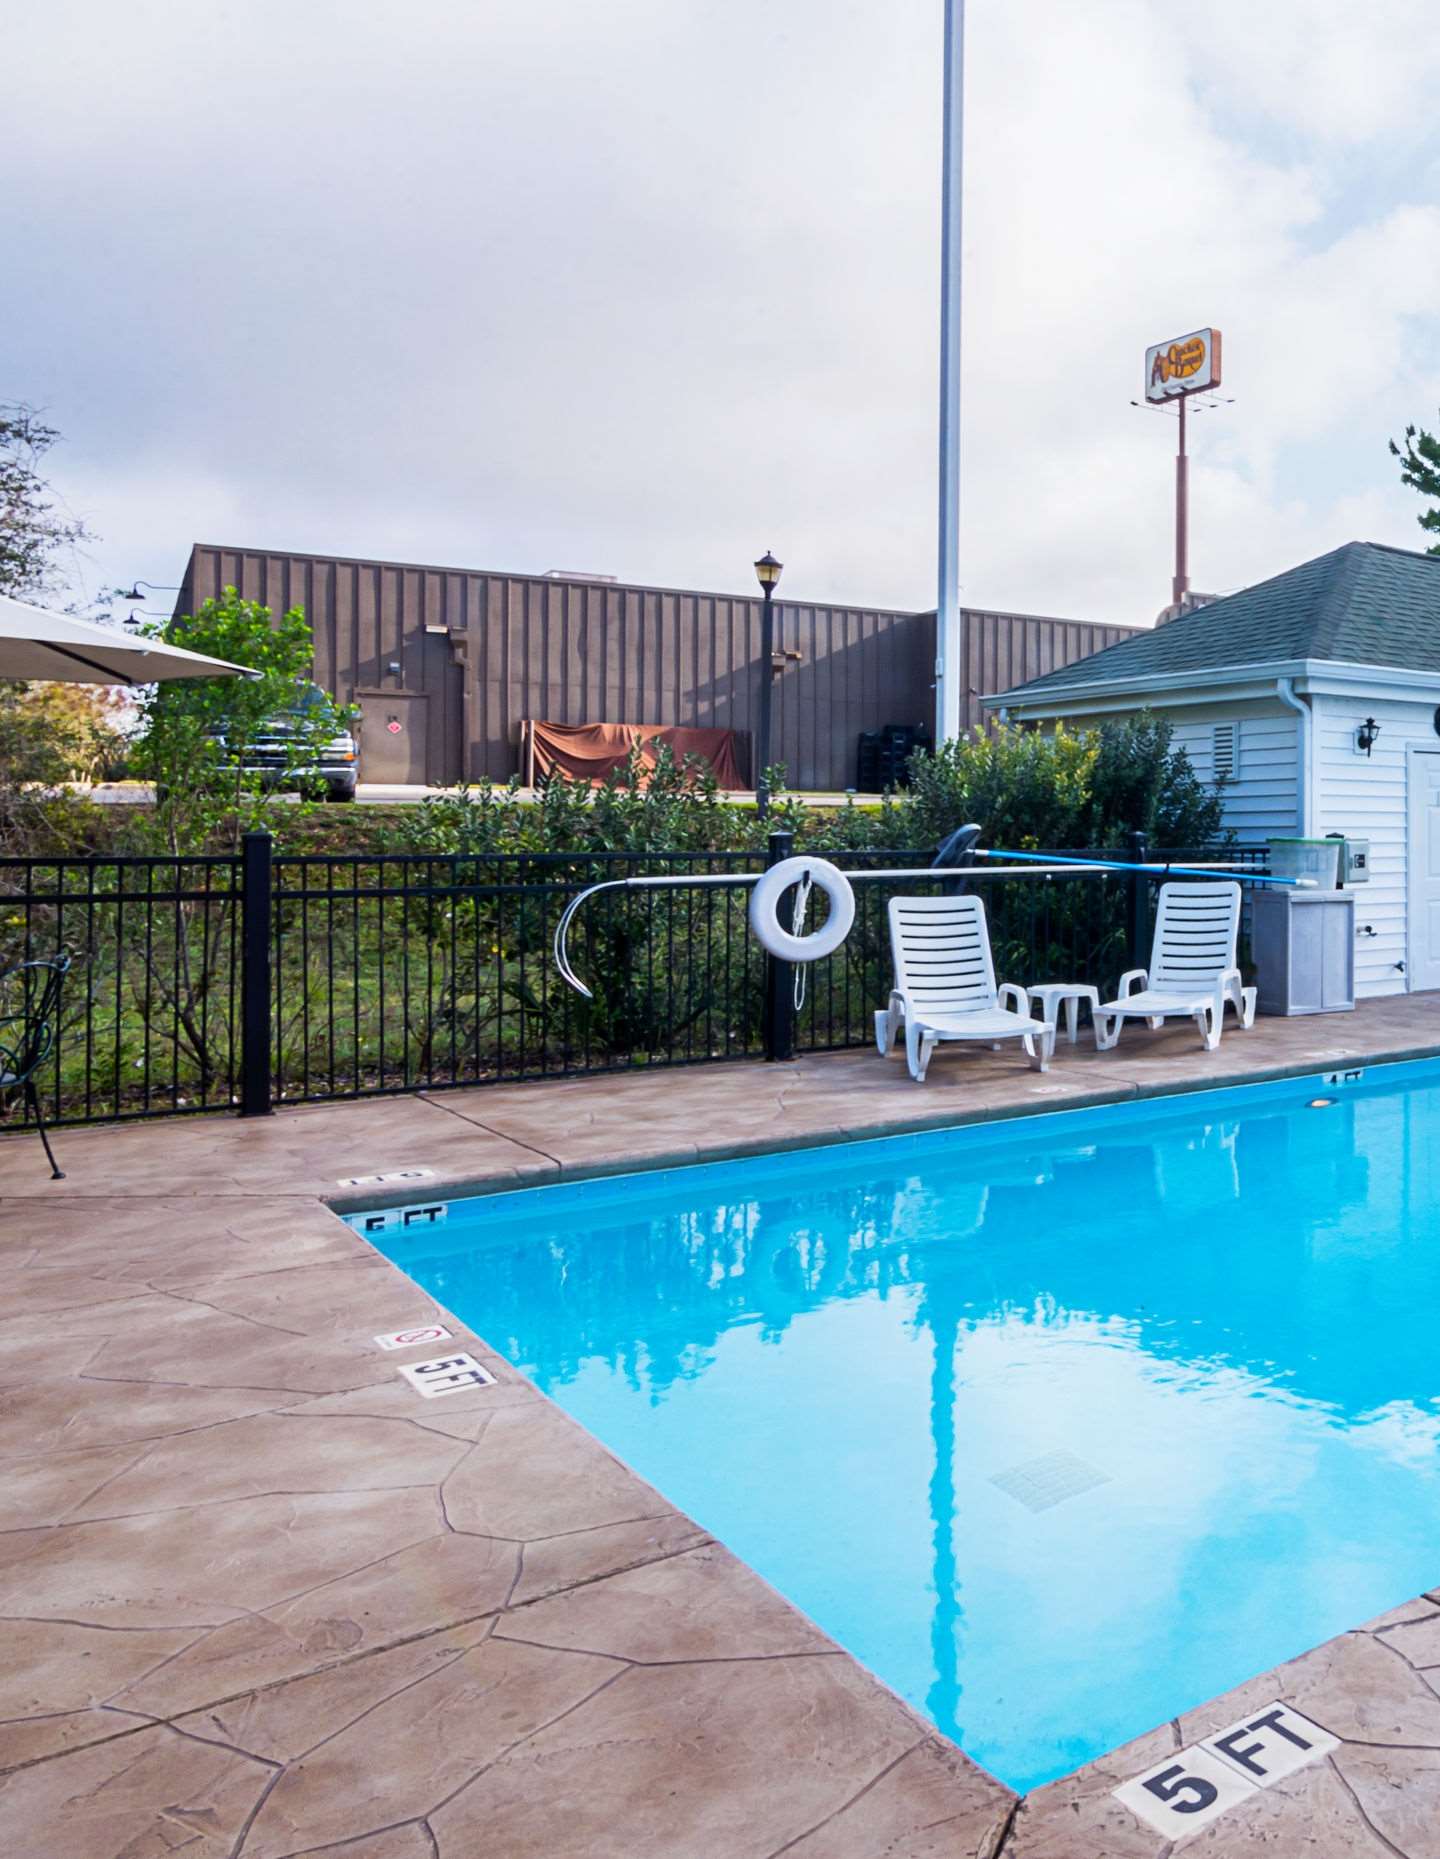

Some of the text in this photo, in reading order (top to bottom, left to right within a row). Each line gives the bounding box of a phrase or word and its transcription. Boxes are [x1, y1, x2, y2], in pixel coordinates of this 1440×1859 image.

[414, 1359, 467, 1374] 5
[1141, 1709, 1313, 1814] 5 FT
